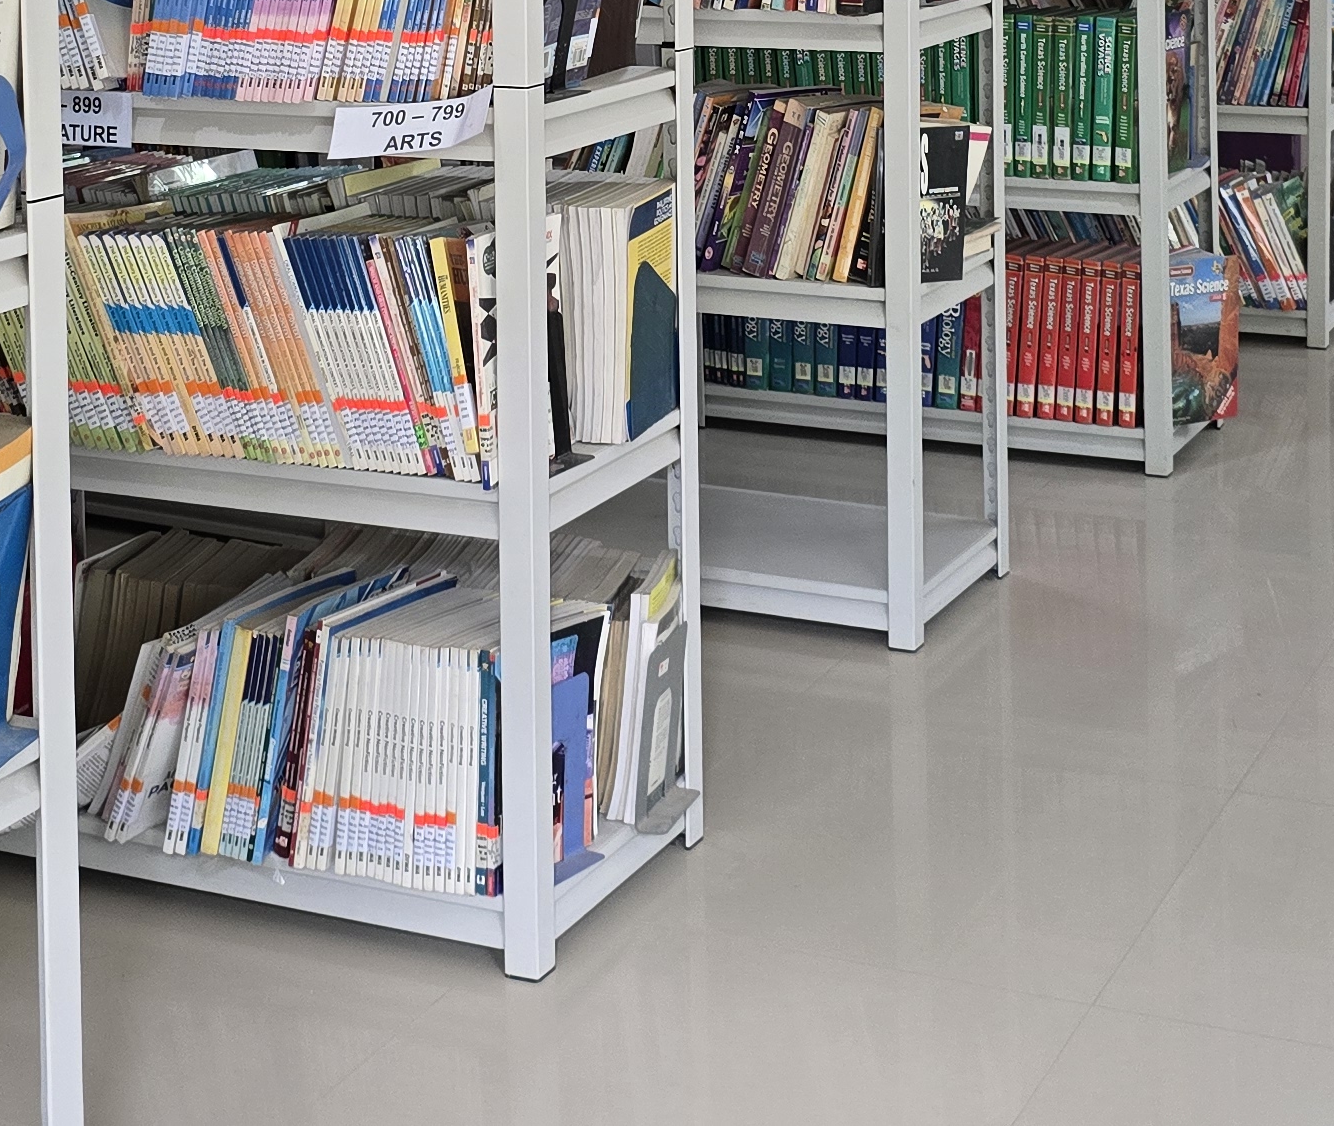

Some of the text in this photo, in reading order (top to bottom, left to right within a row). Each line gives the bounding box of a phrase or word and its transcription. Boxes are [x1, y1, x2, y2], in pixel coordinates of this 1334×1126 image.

[708, 48, 716, 74] Science
[728, 48, 736, 74] Science
[1097, 33, 1105, 76] VOYAGES
[1105, 36, 1113, 74] SCIENCE
[1166, 36, 1185, 51] cience
[1037, 38, 1046, 90] Texas Science
[1058, 40, 1067, 91] Texas Science
[1121, 40, 1131, 92] Texas Science
[72, 96, 102, 114] 899
[371, 103, 465, 128] 700 799
[61, 125, 118, 143] ATURE
[383, 131, 442, 152] ARTS
[748, 128, 779, 209] GEOMETRY
[765, 141, 794, 226] GEOMETRY
[171, 248, 203, 328] Oral Communication
[434, 274, 454, 314] HUMANITIES
[1027, 279, 1038, 329] Texas Science
[1047, 279, 1058, 330] Texas Science
[1170, 279, 1229, 297] Texas Science
[83, 298, 99, 337] Literature
[938, 302, 960, 358] Biology
[248, 324, 264, 359] COMMUNICATION
[479, 698, 488, 736] CREATIVE
[362, 710, 372, 771] Creative NonFiction
